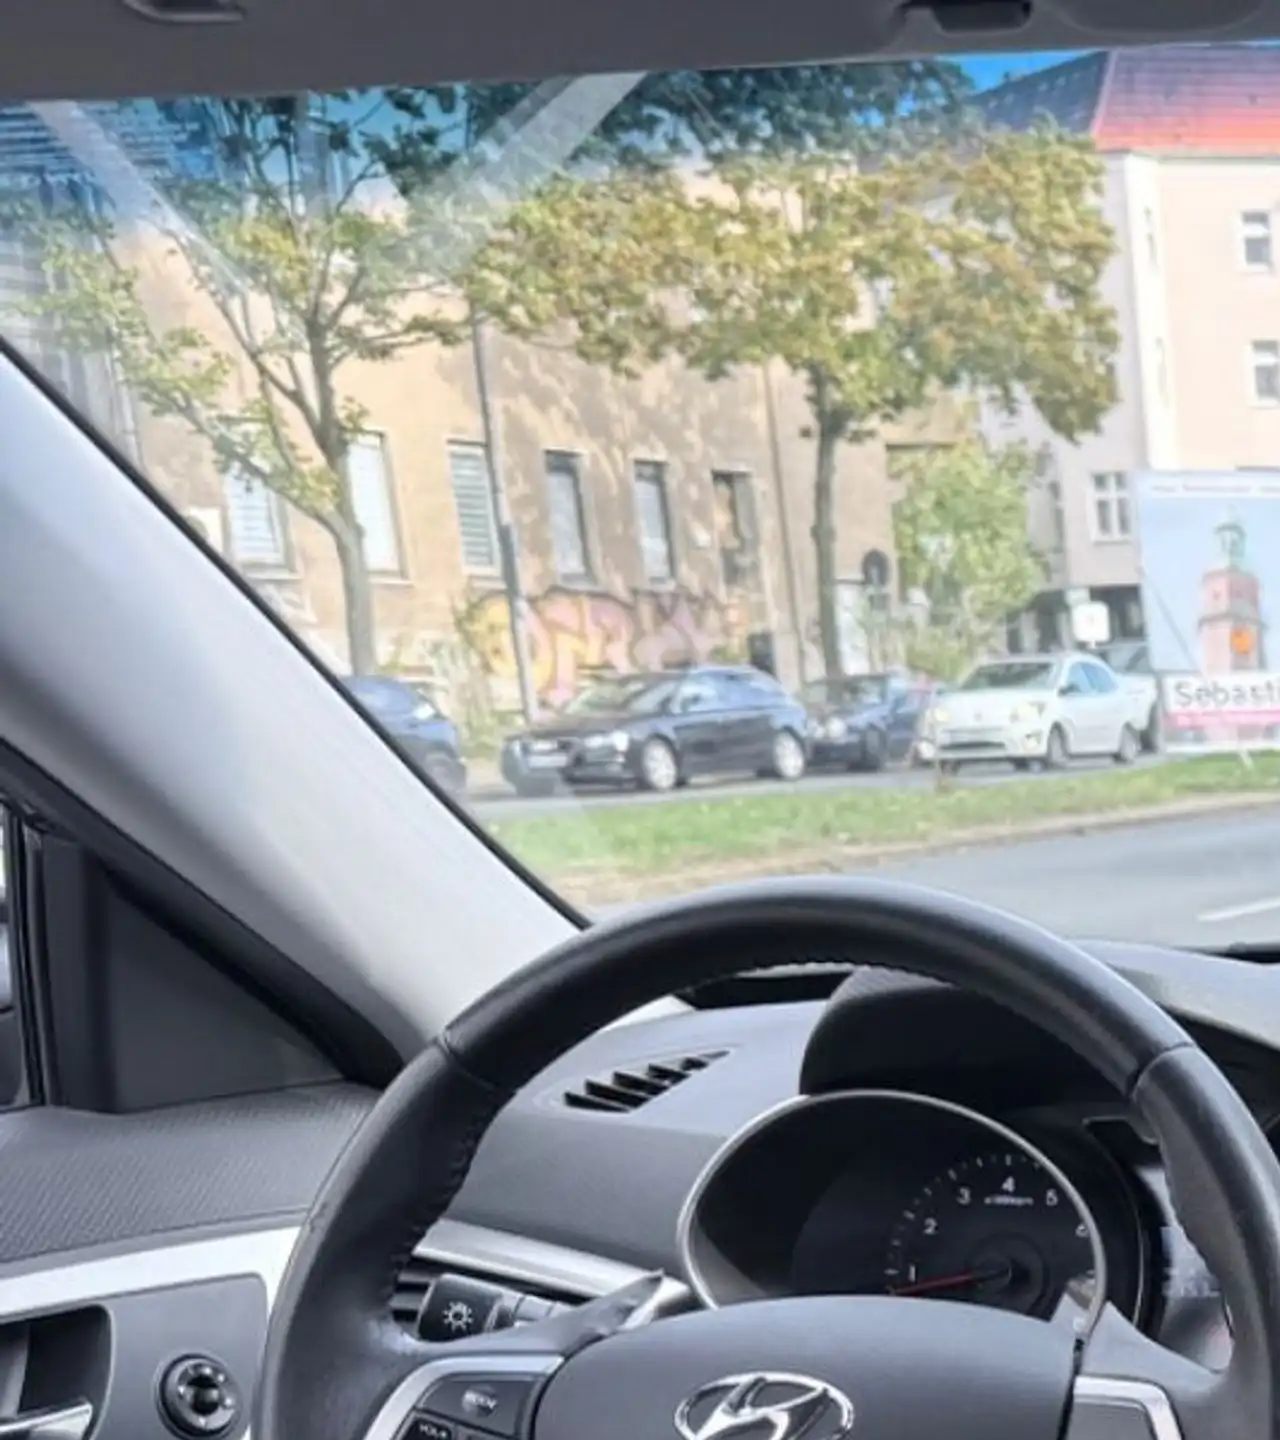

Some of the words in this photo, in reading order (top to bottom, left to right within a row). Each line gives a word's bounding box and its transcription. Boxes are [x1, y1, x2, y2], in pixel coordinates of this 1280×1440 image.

[1001, 1176, 1016, 1192] 4
[957, 1187, 972, 1205] 3
[923, 1217, 939, 1235] 2
